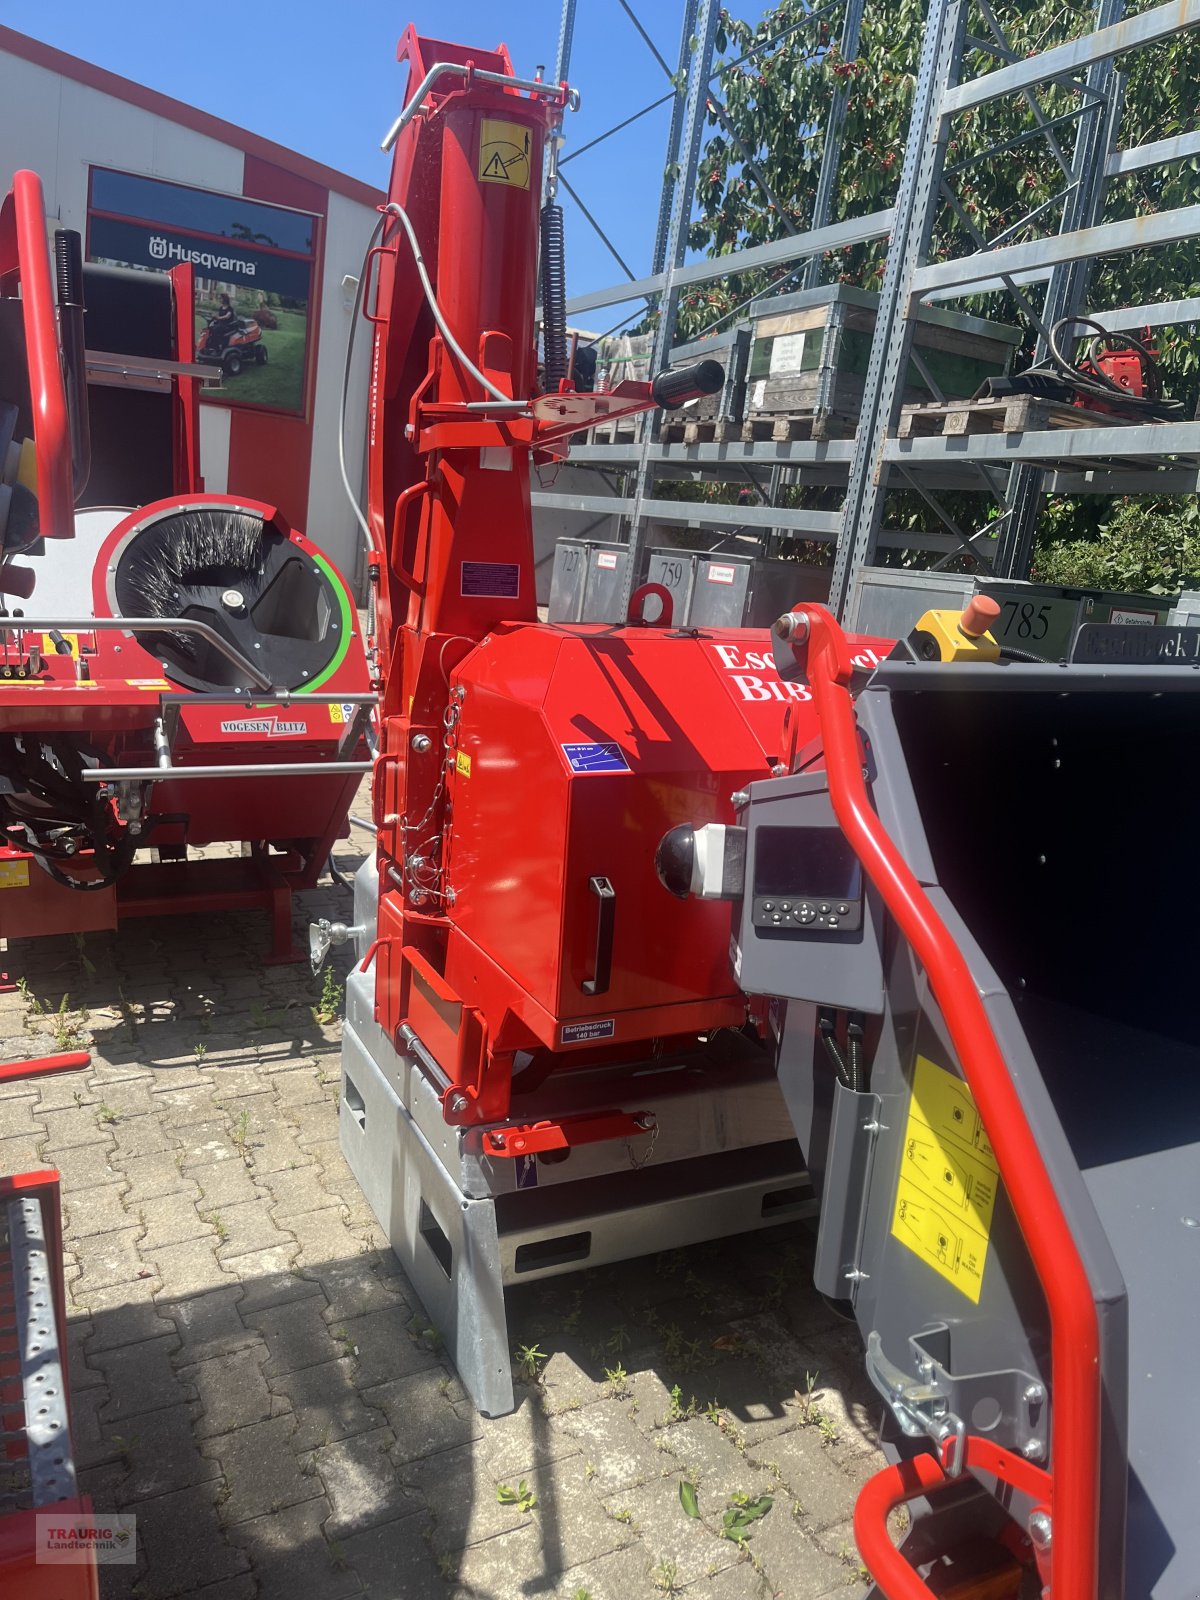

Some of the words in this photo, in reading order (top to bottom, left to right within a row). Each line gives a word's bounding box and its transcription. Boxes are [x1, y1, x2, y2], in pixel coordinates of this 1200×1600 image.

[168, 242, 256, 276] Husqvarna
[660, 561, 683, 588] 759
[1002, 601, 1052, 640] 785
[222, 722, 270, 732] VOGESEN
[276, 722, 306, 732] BLITZ
[565, 1022, 612, 1034] Betriebsdruck
